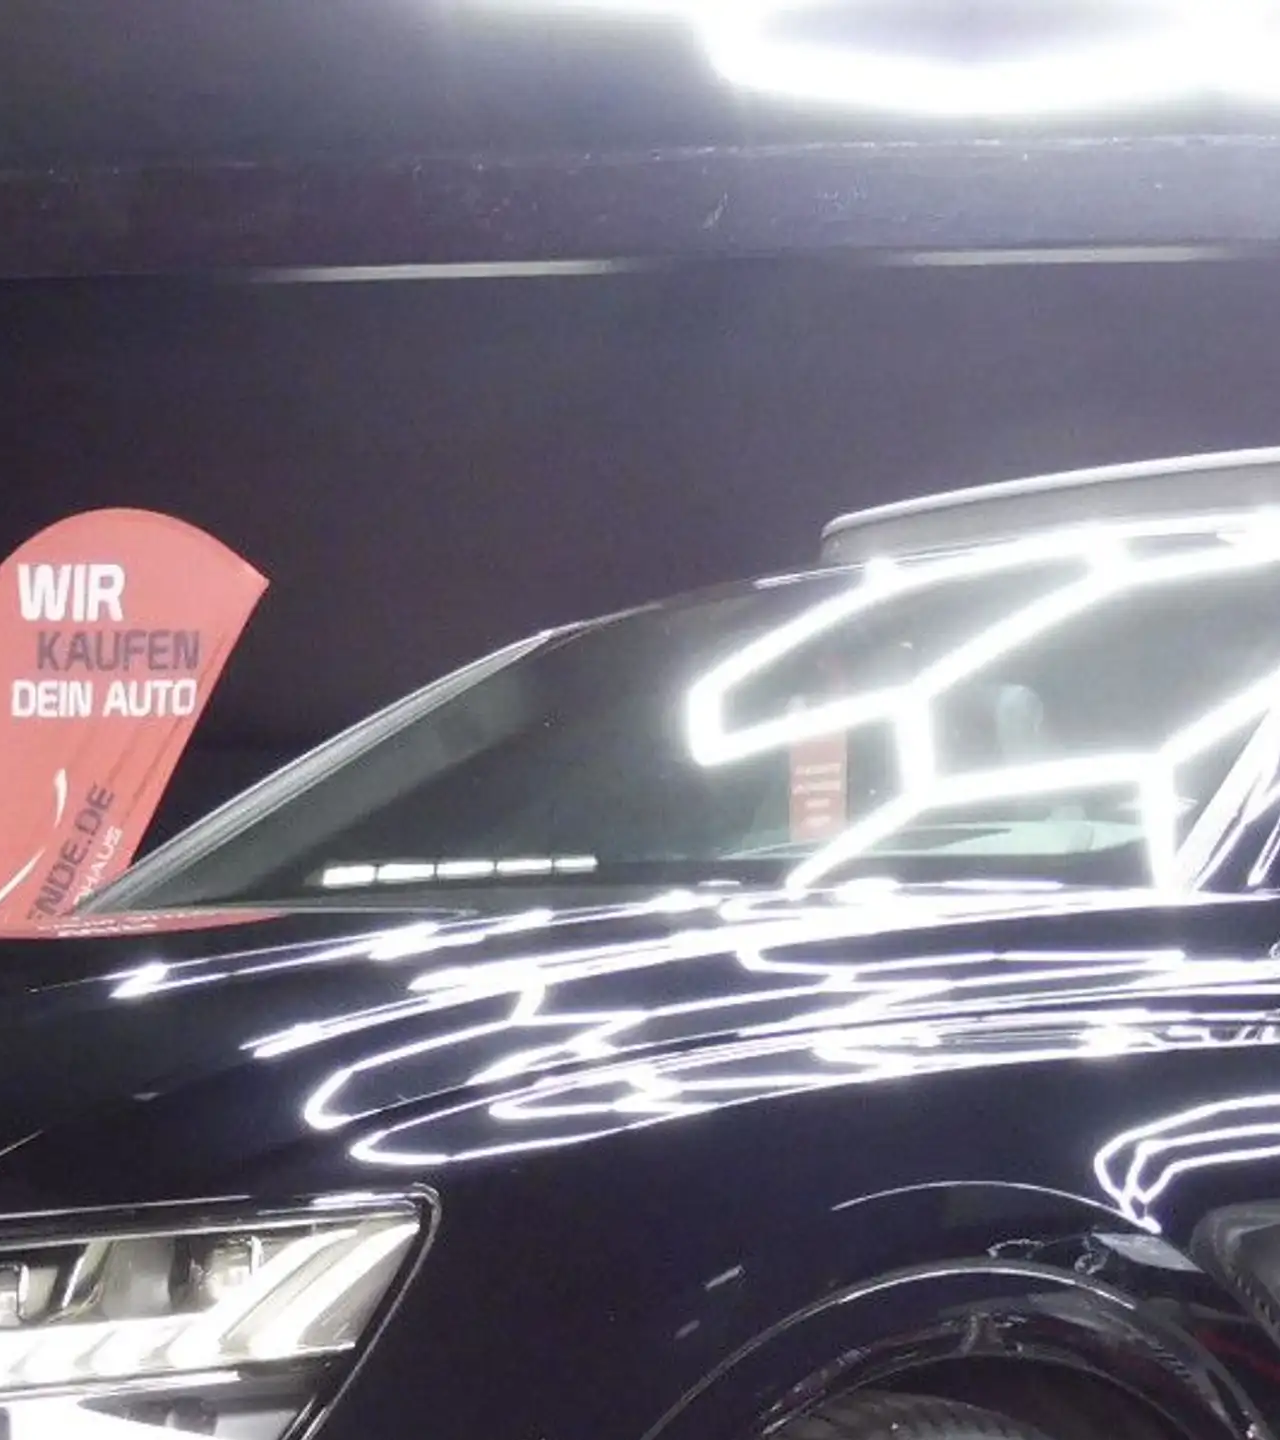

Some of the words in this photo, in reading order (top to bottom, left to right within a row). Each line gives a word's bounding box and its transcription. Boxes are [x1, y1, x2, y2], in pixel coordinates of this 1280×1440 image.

[17, 564, 125, 622] WIR
[36, 629, 201, 673] KAUFEN
[11, 680, 94, 718] DEIN
[103, 679, 198, 718] AUTO
